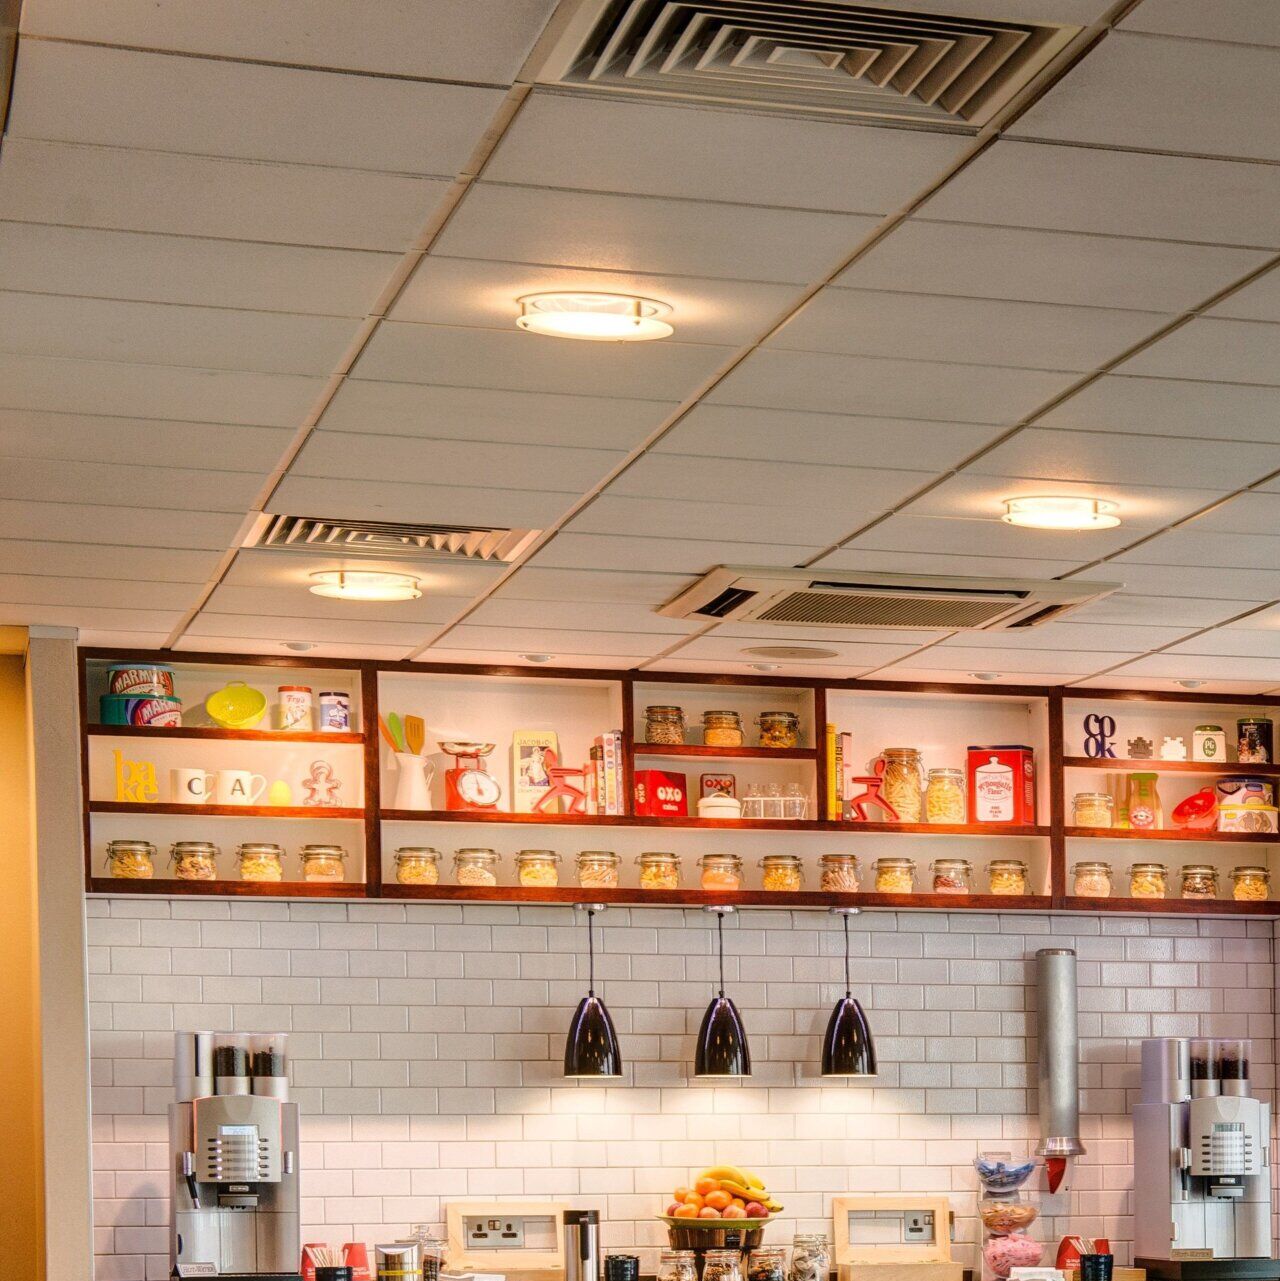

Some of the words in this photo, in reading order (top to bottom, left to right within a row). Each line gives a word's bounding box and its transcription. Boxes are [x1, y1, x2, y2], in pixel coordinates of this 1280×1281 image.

[1204, 740, 1215, 749] PG
[187, 777, 202, 795] C
[231, 778, 245, 795] A
[705, 779, 733, 788] OXO
[657, 786, 682, 802] OXO
